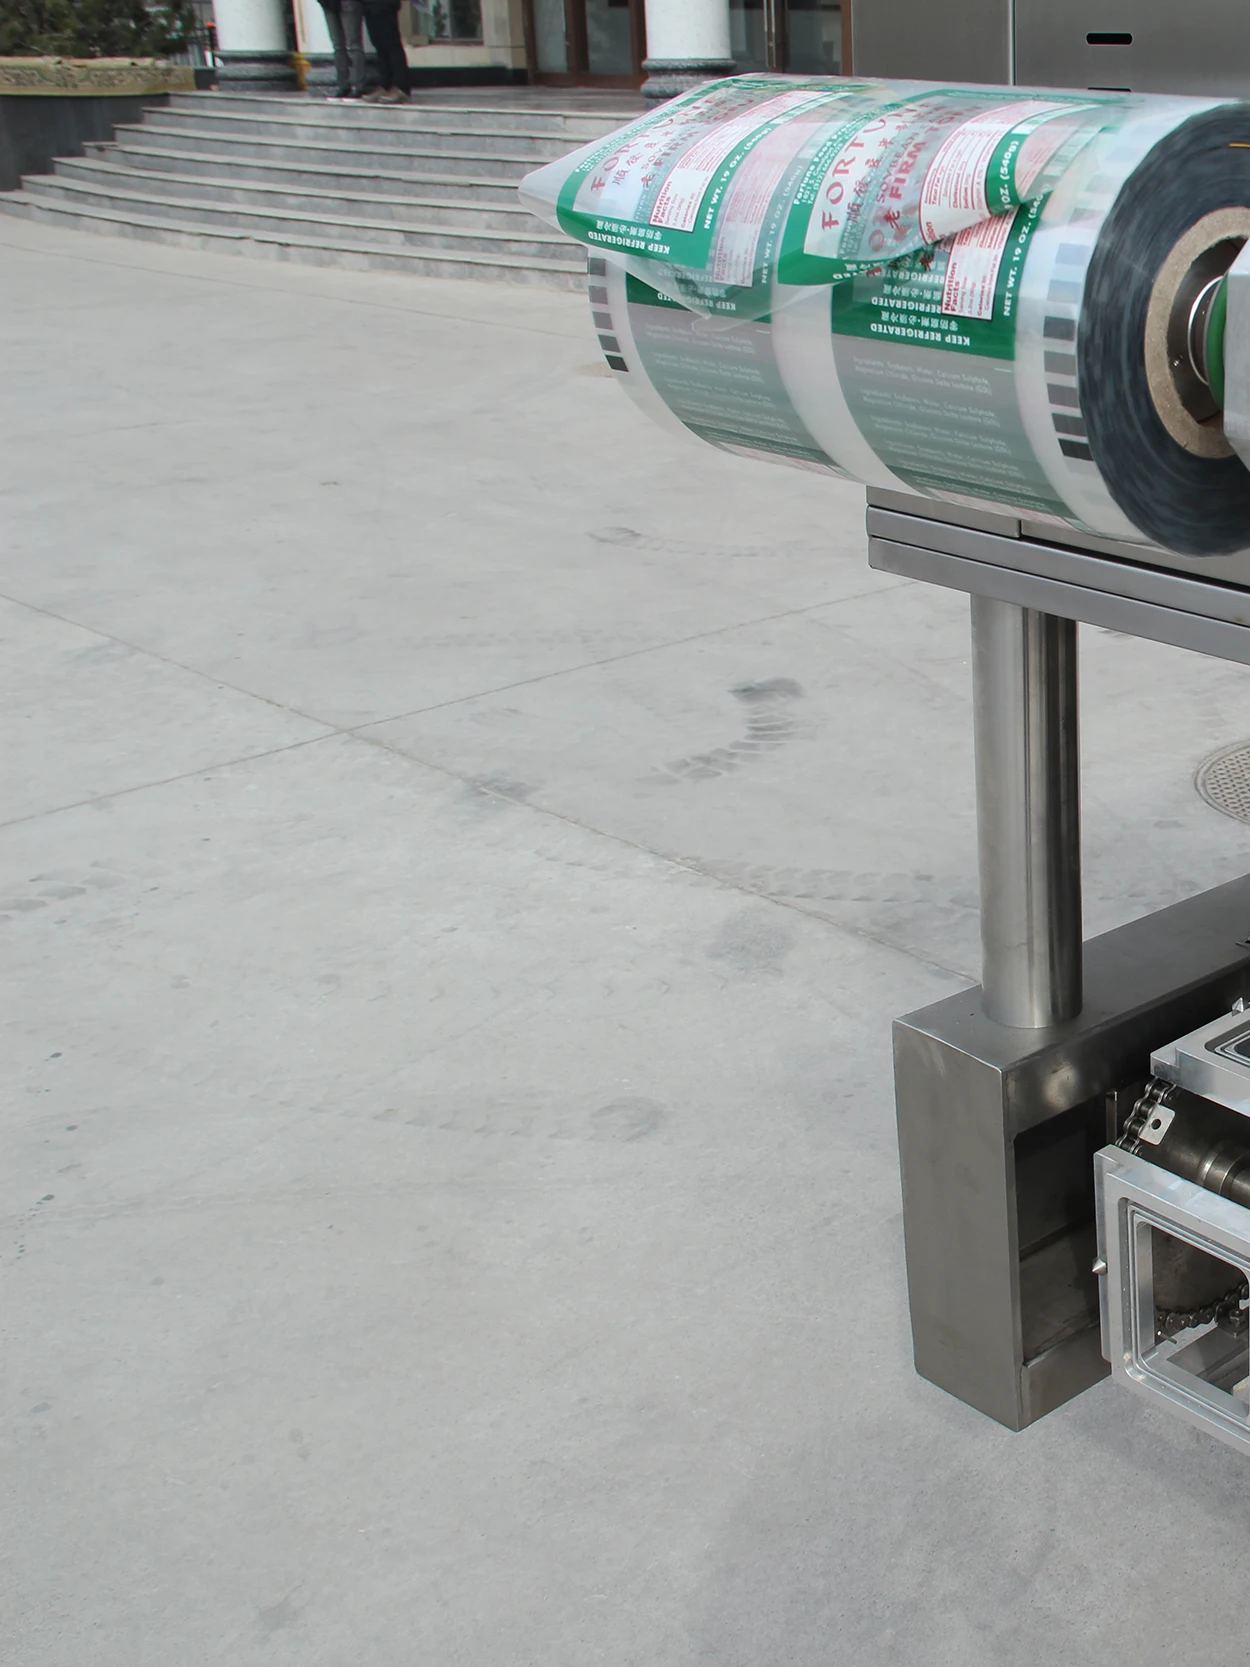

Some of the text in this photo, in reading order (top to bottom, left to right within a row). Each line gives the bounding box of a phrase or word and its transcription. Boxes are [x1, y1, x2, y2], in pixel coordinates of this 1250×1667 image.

[889, 141, 927, 199] FIRM
[653, 181, 672, 223] Nutrition
[704, 207, 715, 229] NET
[711, 186, 723, 204] WT.
[721, 170, 730, 182] 19
[729, 152, 745, 168] OZ.
[1000, 184, 1011, 203] OZ.
[657, 197, 671, 224] Facts
[769, 223, 777, 235] 19
[1018, 222, 1031, 243] OZ.
[588, 231, 670, 254] KEEP REFRIGERATED
[764, 240, 773, 259] WT.
[1013, 247, 1021, 262] 19
[761, 262, 769, 284] NET
[1007, 267, 1018, 288] WT.
[944, 262, 957, 312] Nutrition
[950, 281, 960, 312] Facts
[871, 296, 943, 313] REFRIGERATED
[1003, 292, 1012, 316] NET
[870, 323, 970, 346] KEEP REFRIGERATED
